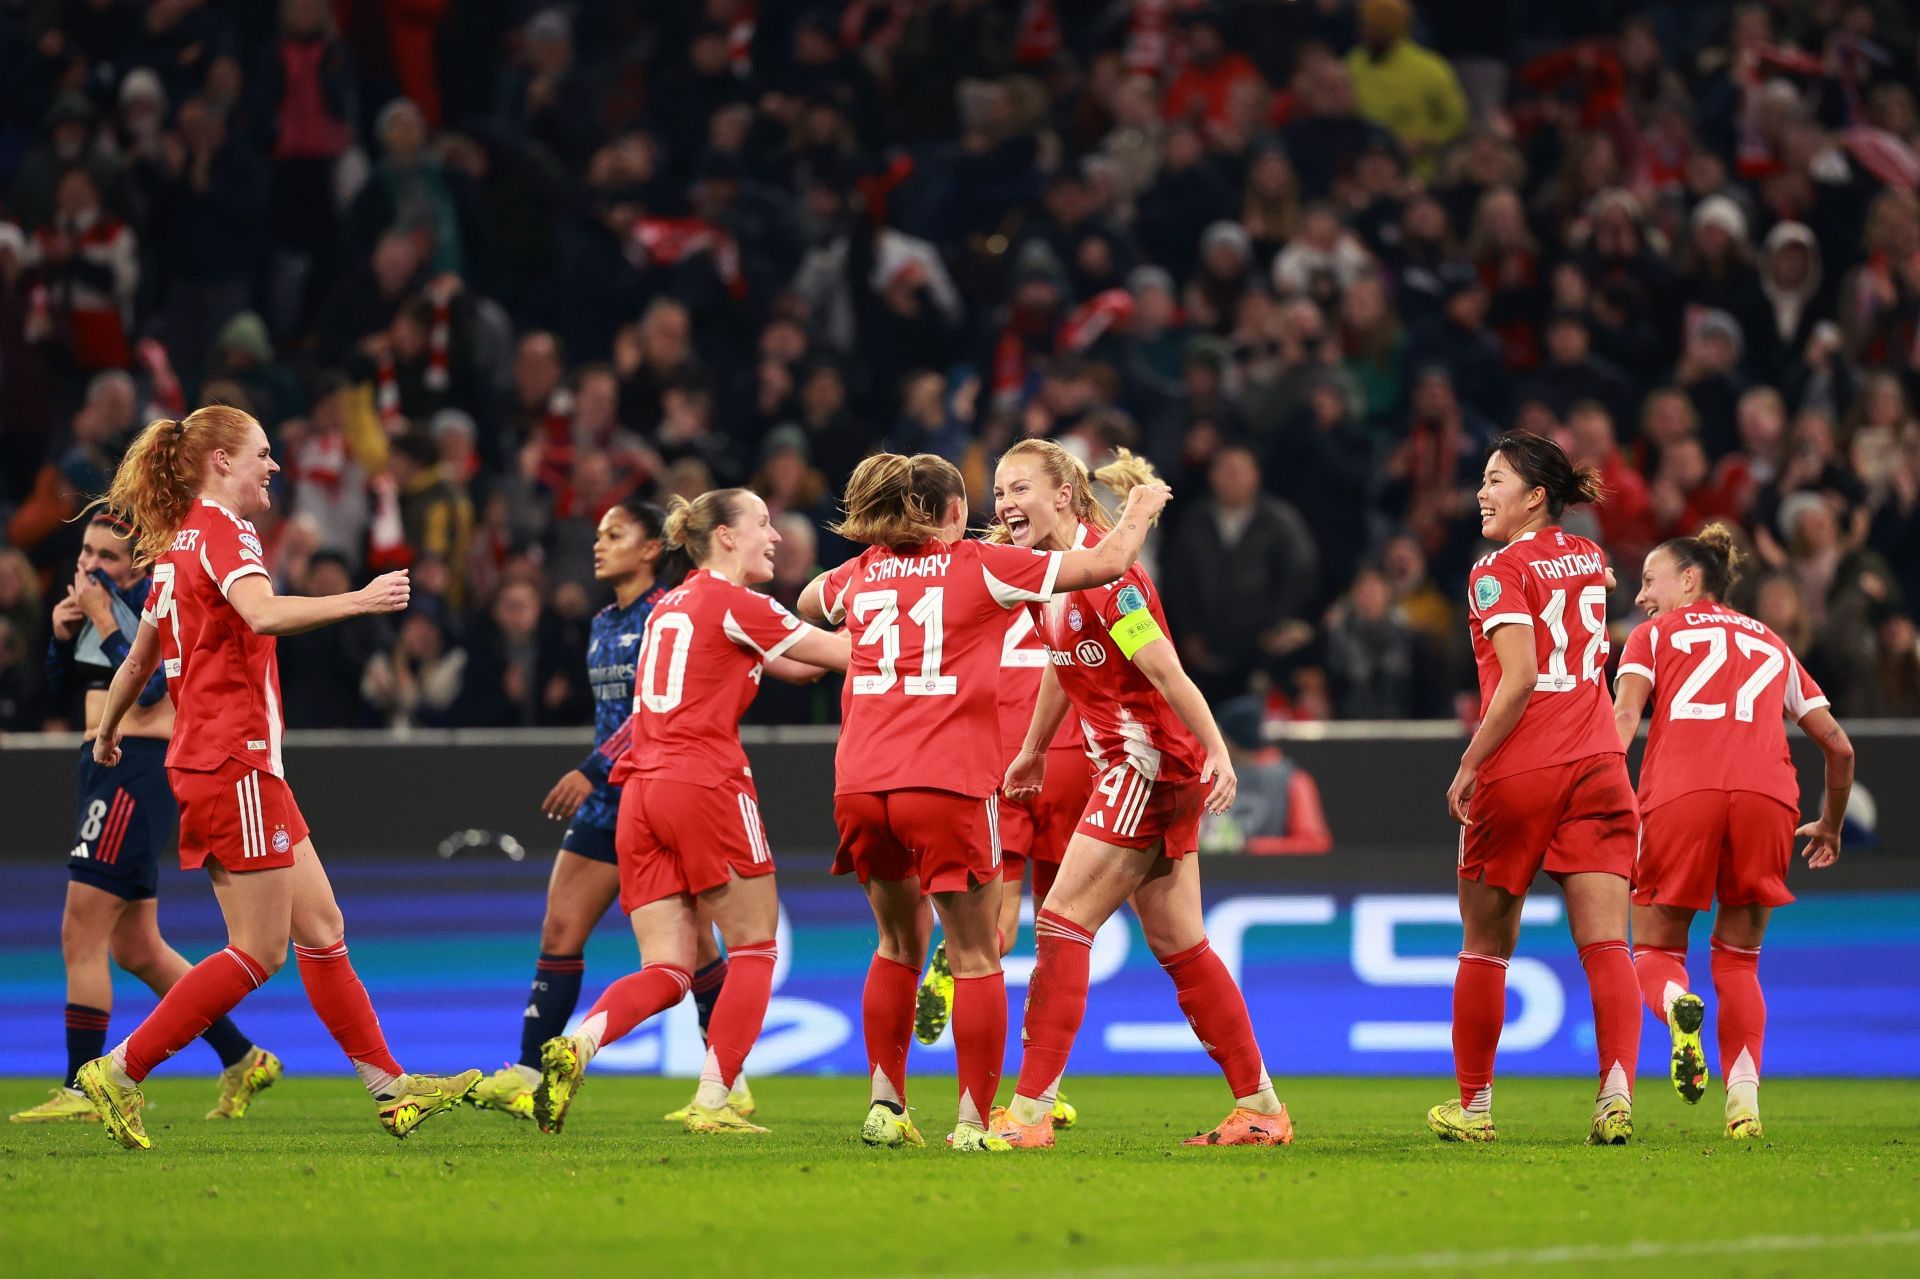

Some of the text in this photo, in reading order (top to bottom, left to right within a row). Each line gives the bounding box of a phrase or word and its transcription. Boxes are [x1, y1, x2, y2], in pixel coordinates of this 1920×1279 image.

[865, 553, 951, 582] STANWAY
[852, 586, 957, 695] 31
[1684, 612, 1765, 635] CARUSO
[1669, 626, 1785, 723] 27
[1097, 762, 1130, 808] 4
[81, 799, 107, 841] 8
